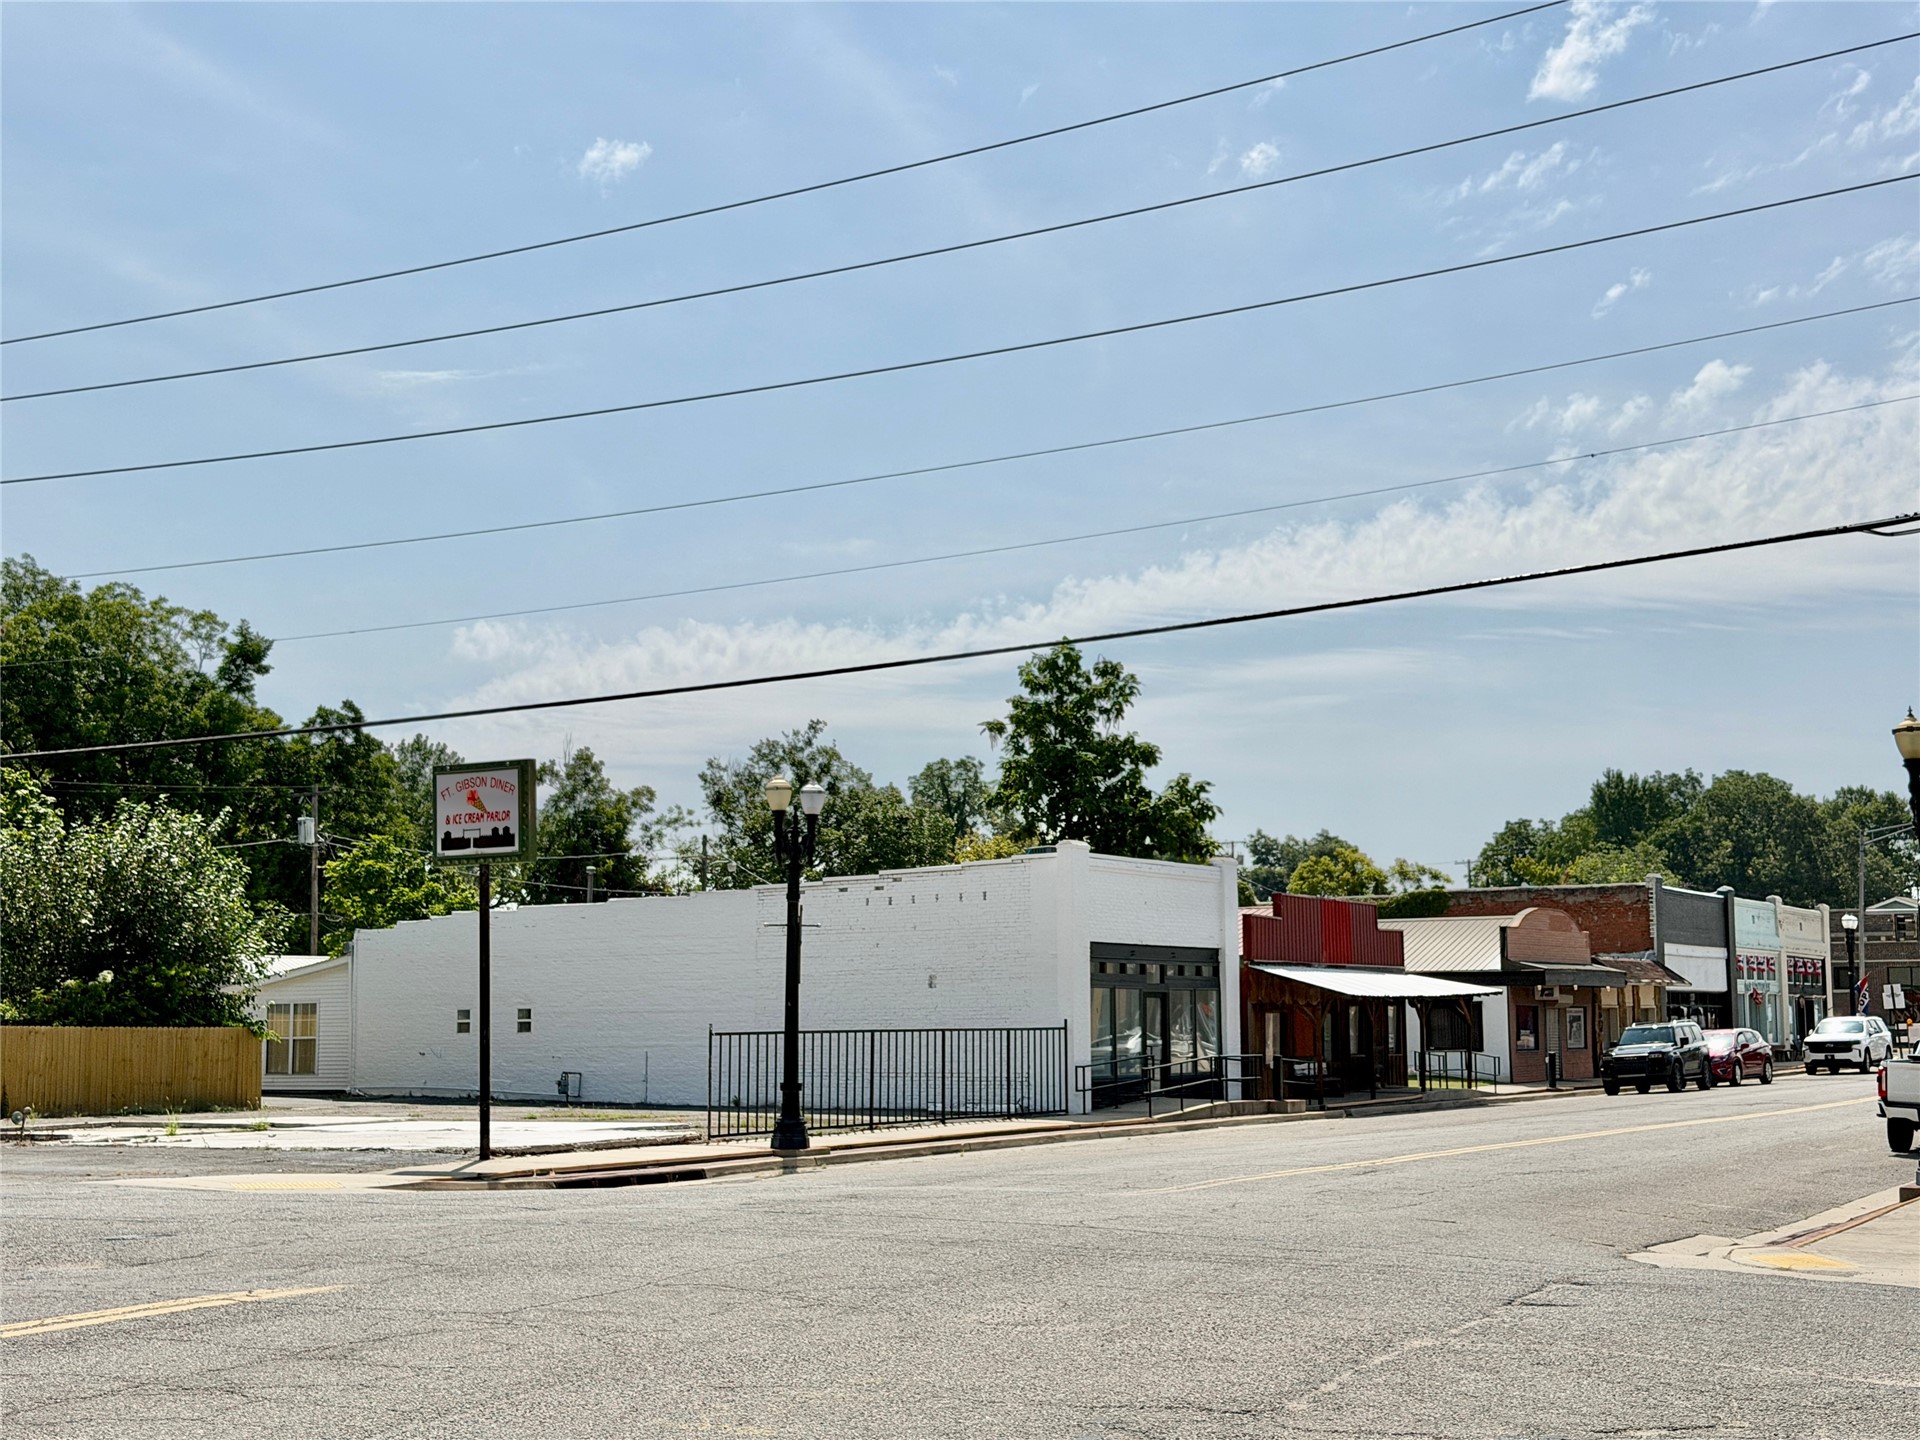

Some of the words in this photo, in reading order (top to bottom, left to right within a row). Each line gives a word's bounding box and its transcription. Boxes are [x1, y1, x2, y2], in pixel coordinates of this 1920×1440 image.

[440, 787, 454, 801] FT.
[455, 776, 488, 793] GIBSON
[490, 777, 516, 796] DINER
[445, 815, 451, 825] &
[453, 814, 462, 824] ICE
[464, 812, 485, 824] CREAM
[486, 810, 511, 822] PARLOR
